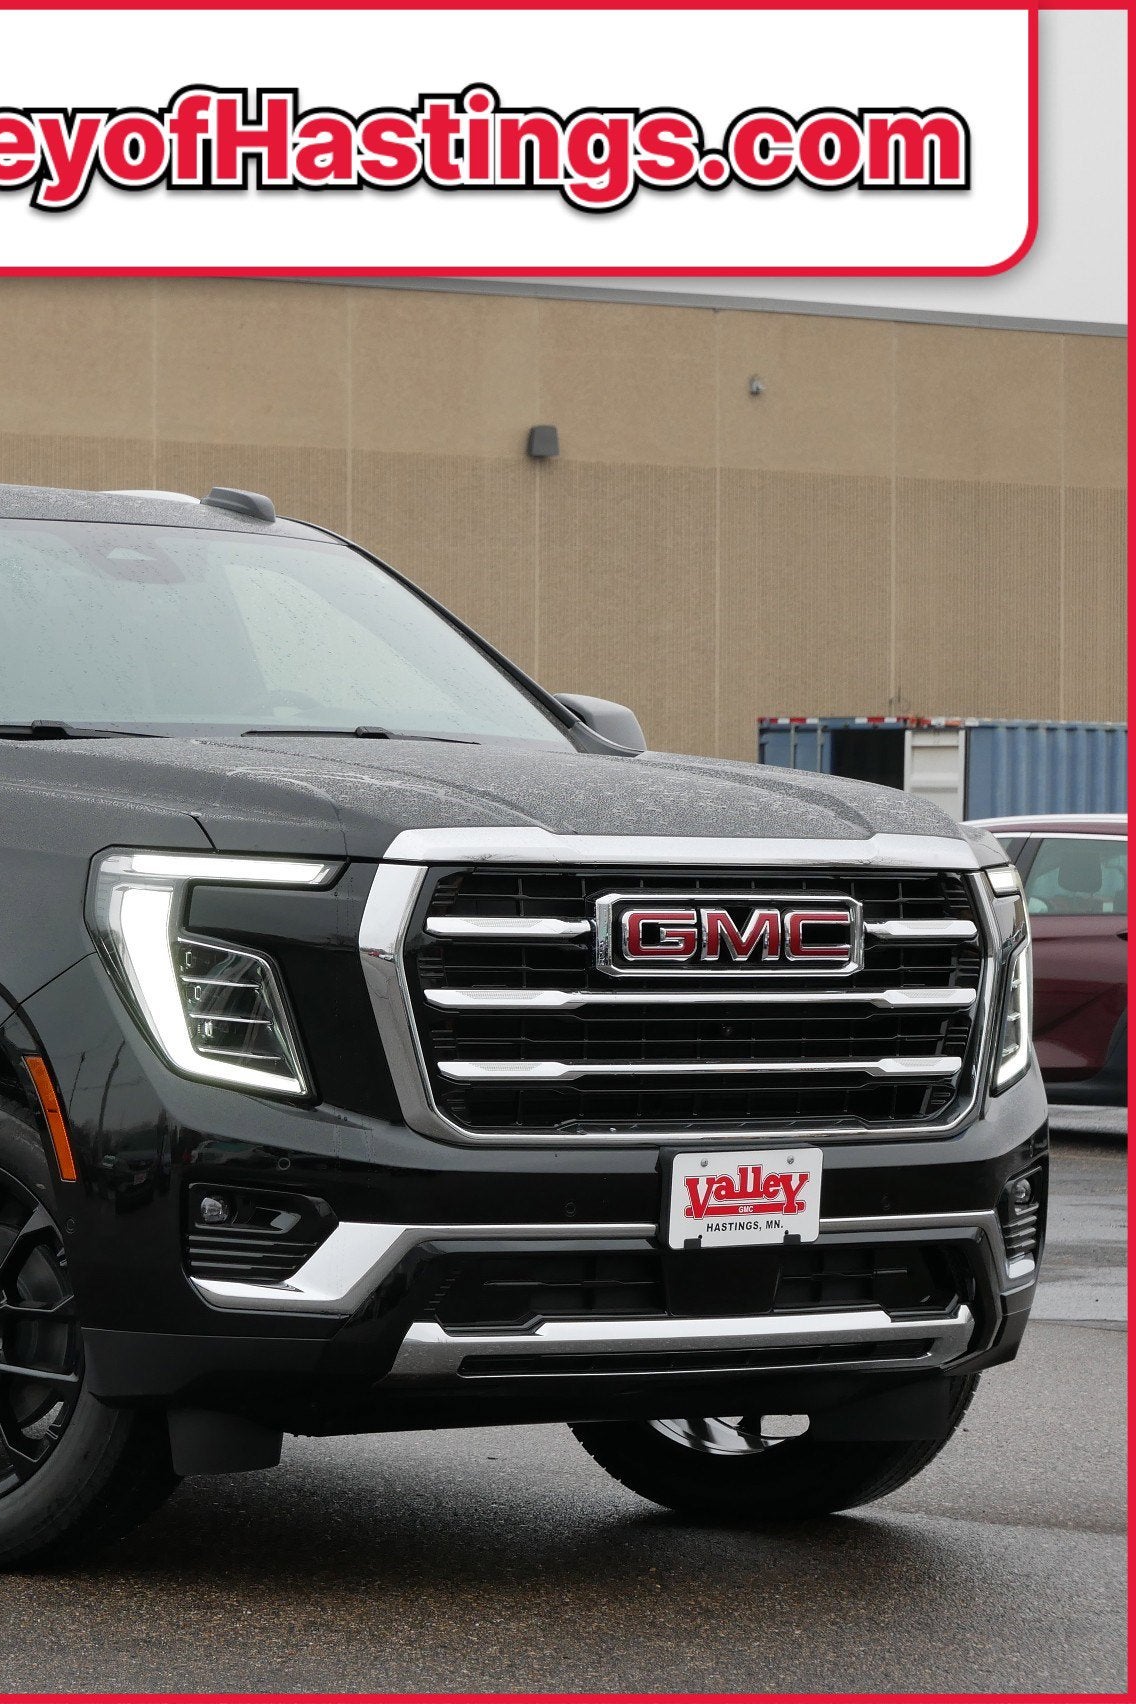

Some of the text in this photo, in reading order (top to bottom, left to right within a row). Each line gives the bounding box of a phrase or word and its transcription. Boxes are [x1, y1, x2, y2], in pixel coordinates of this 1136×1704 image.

[621, 908, 851, 962] GMC
[738, 1205, 754, 1214] GMC
[706, 1219, 784, 1232] HASTINGS, MN.
